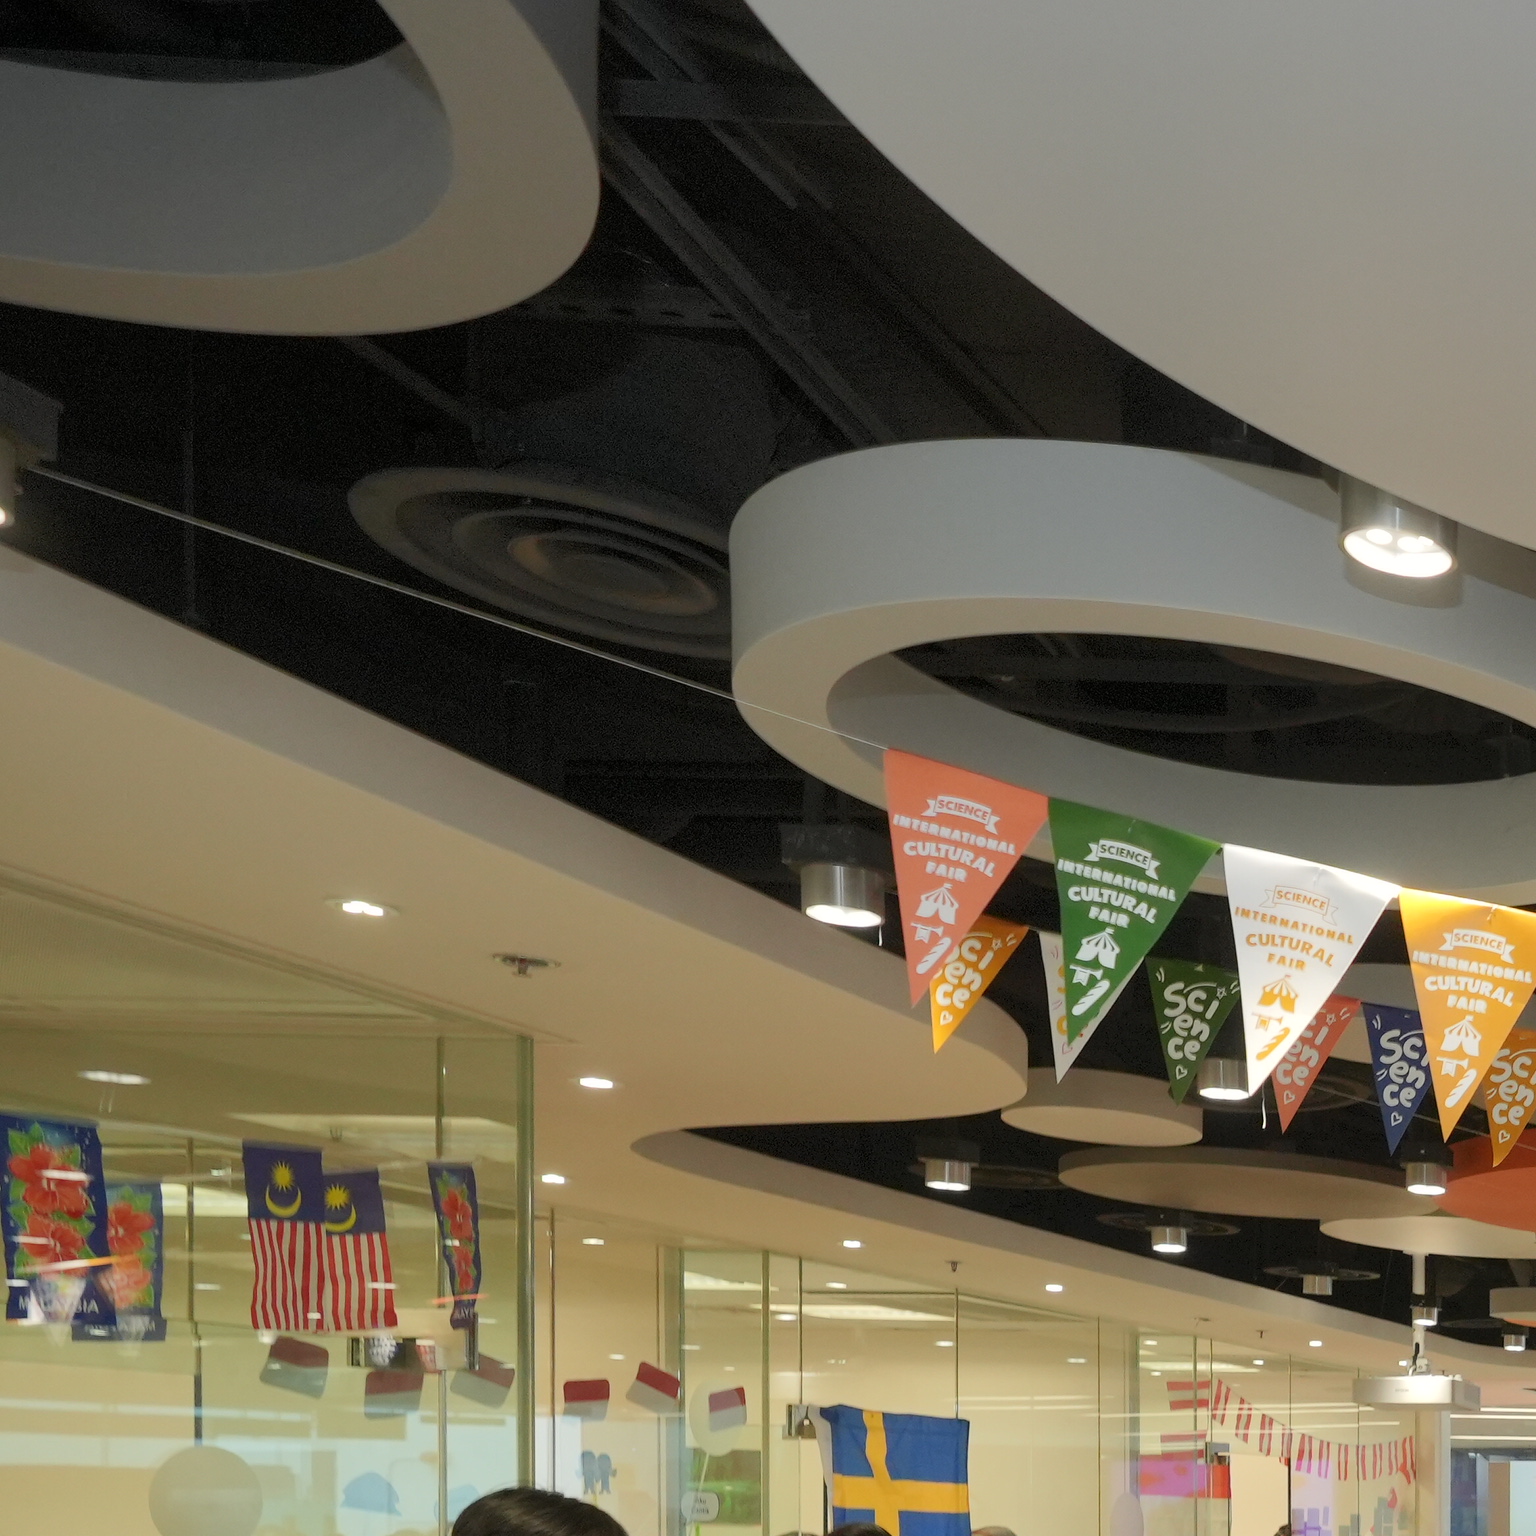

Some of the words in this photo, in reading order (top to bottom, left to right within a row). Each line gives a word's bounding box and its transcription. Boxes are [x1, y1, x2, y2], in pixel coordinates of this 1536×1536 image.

[937, 799, 988, 820] SCIENCE
[893, 814, 1016, 856] INTERNATIONAL
[904, 841, 996, 878] CULTURAL
[1099, 844, 1148, 865] SCIENCE
[924, 860, 967, 882] FAIR
[1057, 858, 1176, 902] INTERNATIONAL
[1068, 886, 1157, 924] CULTURAL
[1276, 890, 1325, 911] SCIENCE
[1088, 906, 1129, 928] FAIR
[1235, 906, 1354, 946] INTERNATIONAL
[1245, 933, 1335, 968] CULTURAL
[1454, 933, 1503, 950] SCIENCE
[1266, 952, 1308, 973] FAIR
[1414, 950, 1532, 983] INTERNATIONAL
[1425, 976, 1513, 1007] CULTURAL
[1446, 994, 1487, 1013] FAIR
